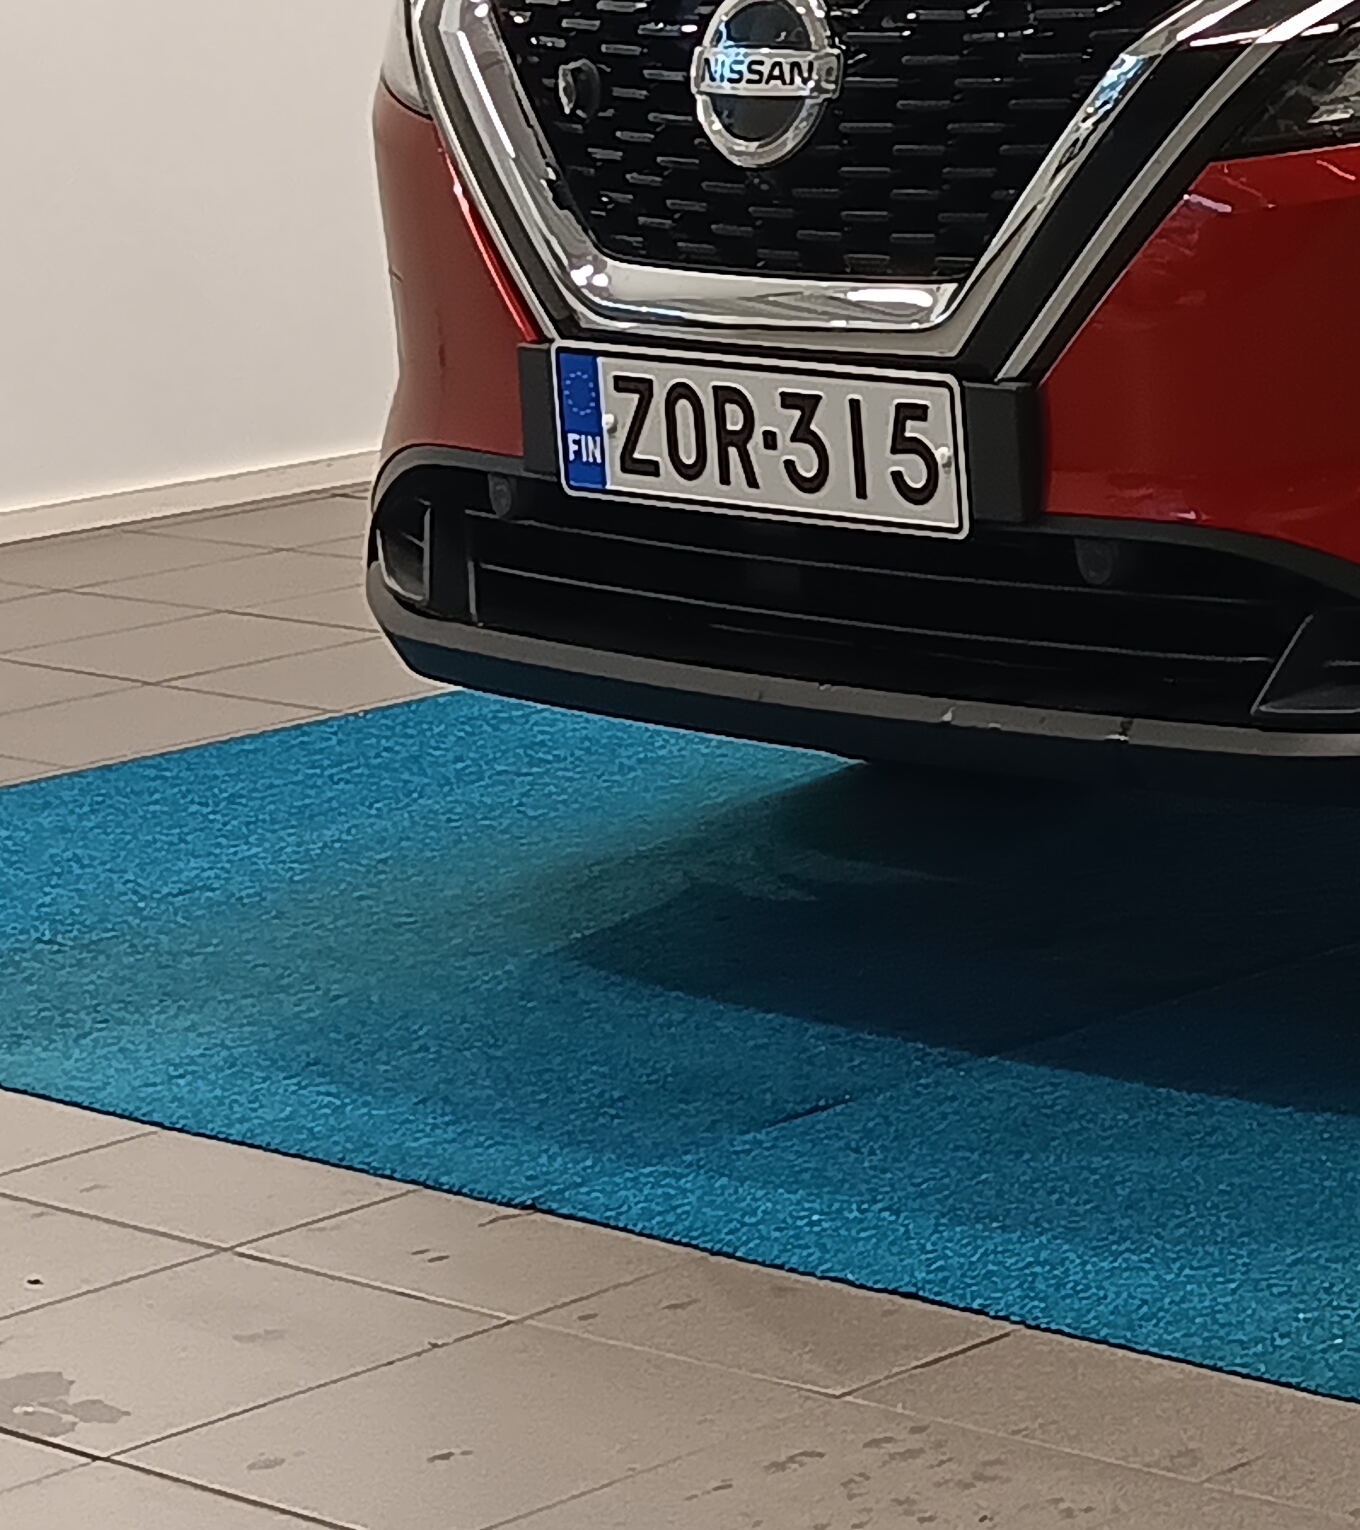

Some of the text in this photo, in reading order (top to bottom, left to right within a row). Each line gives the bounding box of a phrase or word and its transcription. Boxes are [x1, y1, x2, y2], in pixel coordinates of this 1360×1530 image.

[700, 57, 815, 86] NISSAN
[567, 432, 601, 463] FIN
[613, 374, 939, 506] ZOR-315
